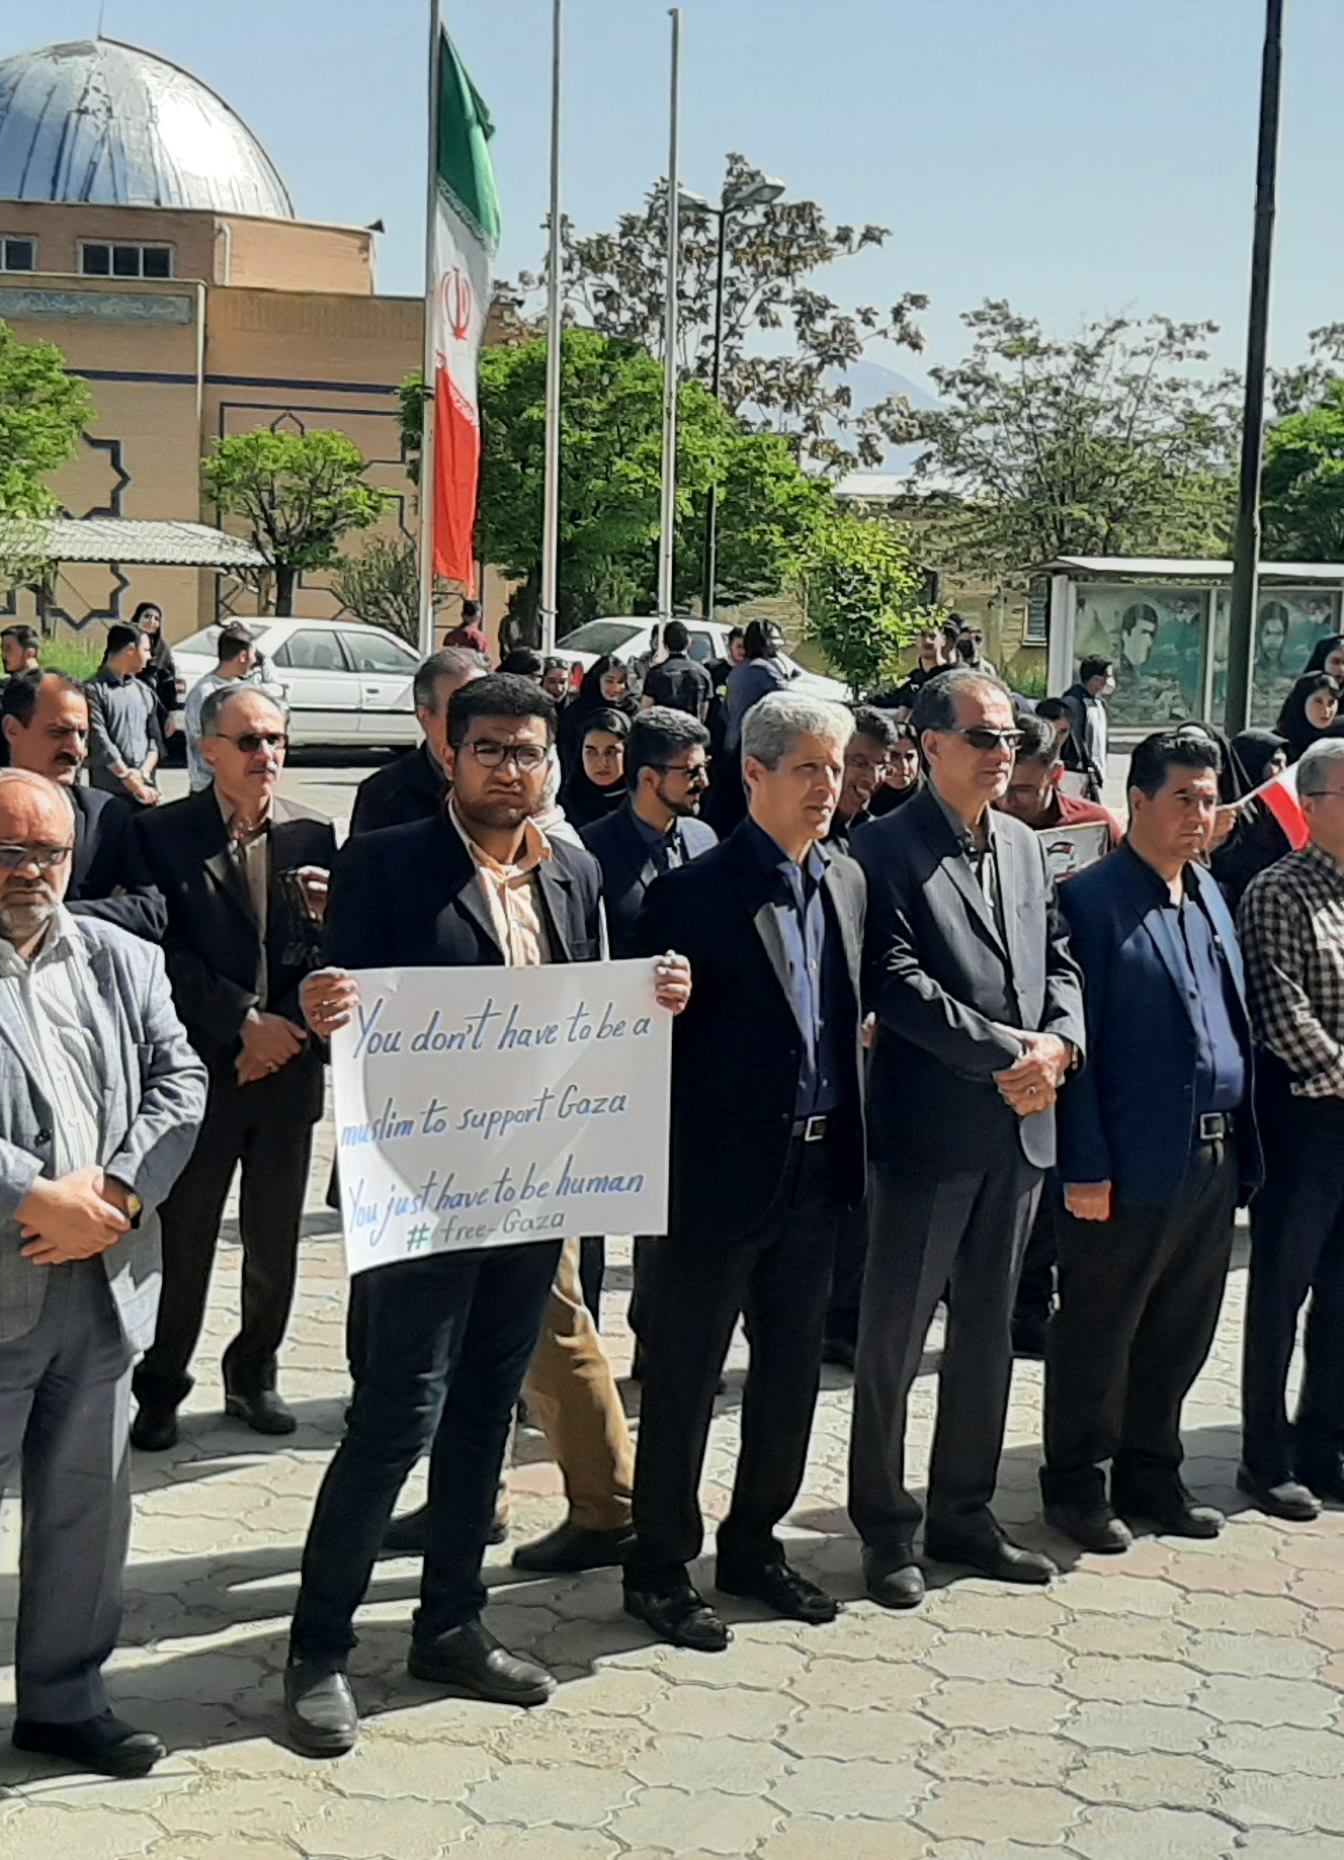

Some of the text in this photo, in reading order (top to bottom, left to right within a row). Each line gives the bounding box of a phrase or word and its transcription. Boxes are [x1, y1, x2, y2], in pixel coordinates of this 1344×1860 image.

[353, 998, 651, 1058] You don't have to be a
[341, 1084, 627, 1147] muslim to support Gaza
[348, 1154, 645, 1247] You just have to be human
